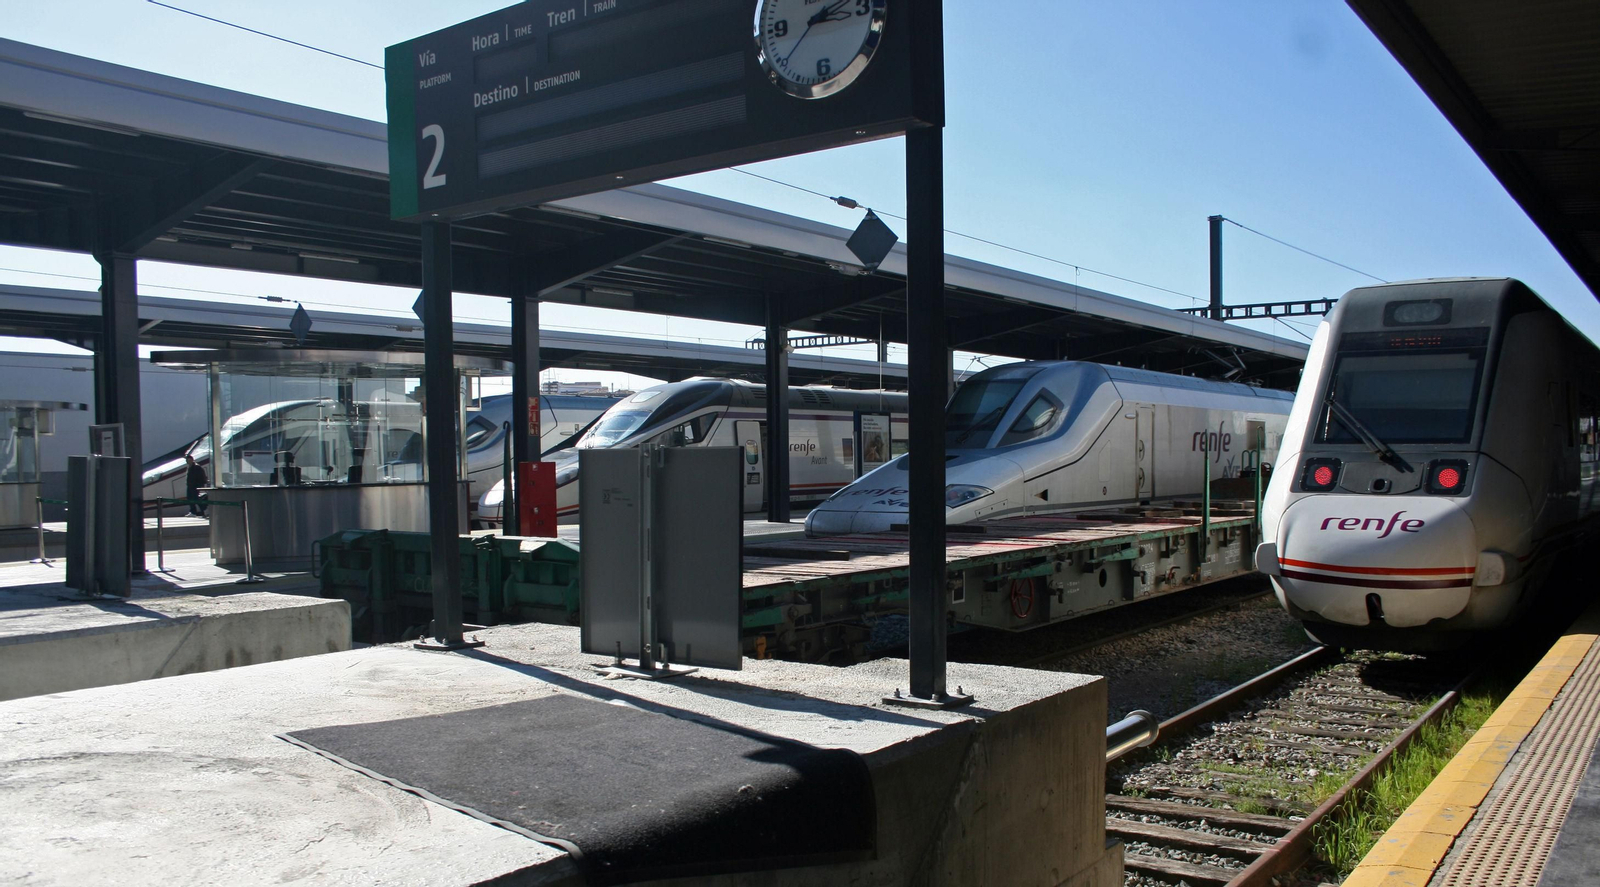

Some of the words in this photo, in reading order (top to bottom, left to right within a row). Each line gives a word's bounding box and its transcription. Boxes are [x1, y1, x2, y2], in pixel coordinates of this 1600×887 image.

[547, 7, 575, 28] Tren
[593, 0, 616, 14] TRAIN
[856, 0, 870, 16] 3
[472, 31, 499, 51] Hora
[514, 24, 532, 38] TIME
[774, 20, 788, 37] 9
[419, 50, 436, 68] Vía
[816, 58, 831, 76] 6
[419, 72, 452, 89] PLATFORM
[473, 84, 518, 108] Destino
[534, 70, 581, 92] DESTINATION
[421, 124, 446, 190] 2
[789, 439, 816, 456] renfe
[1192, 420, 1231, 463] renfe
[811, 456, 828, 465] Avant
[841, 486, 909, 497] renfe
[1320, 510, 1426, 539] renfe
